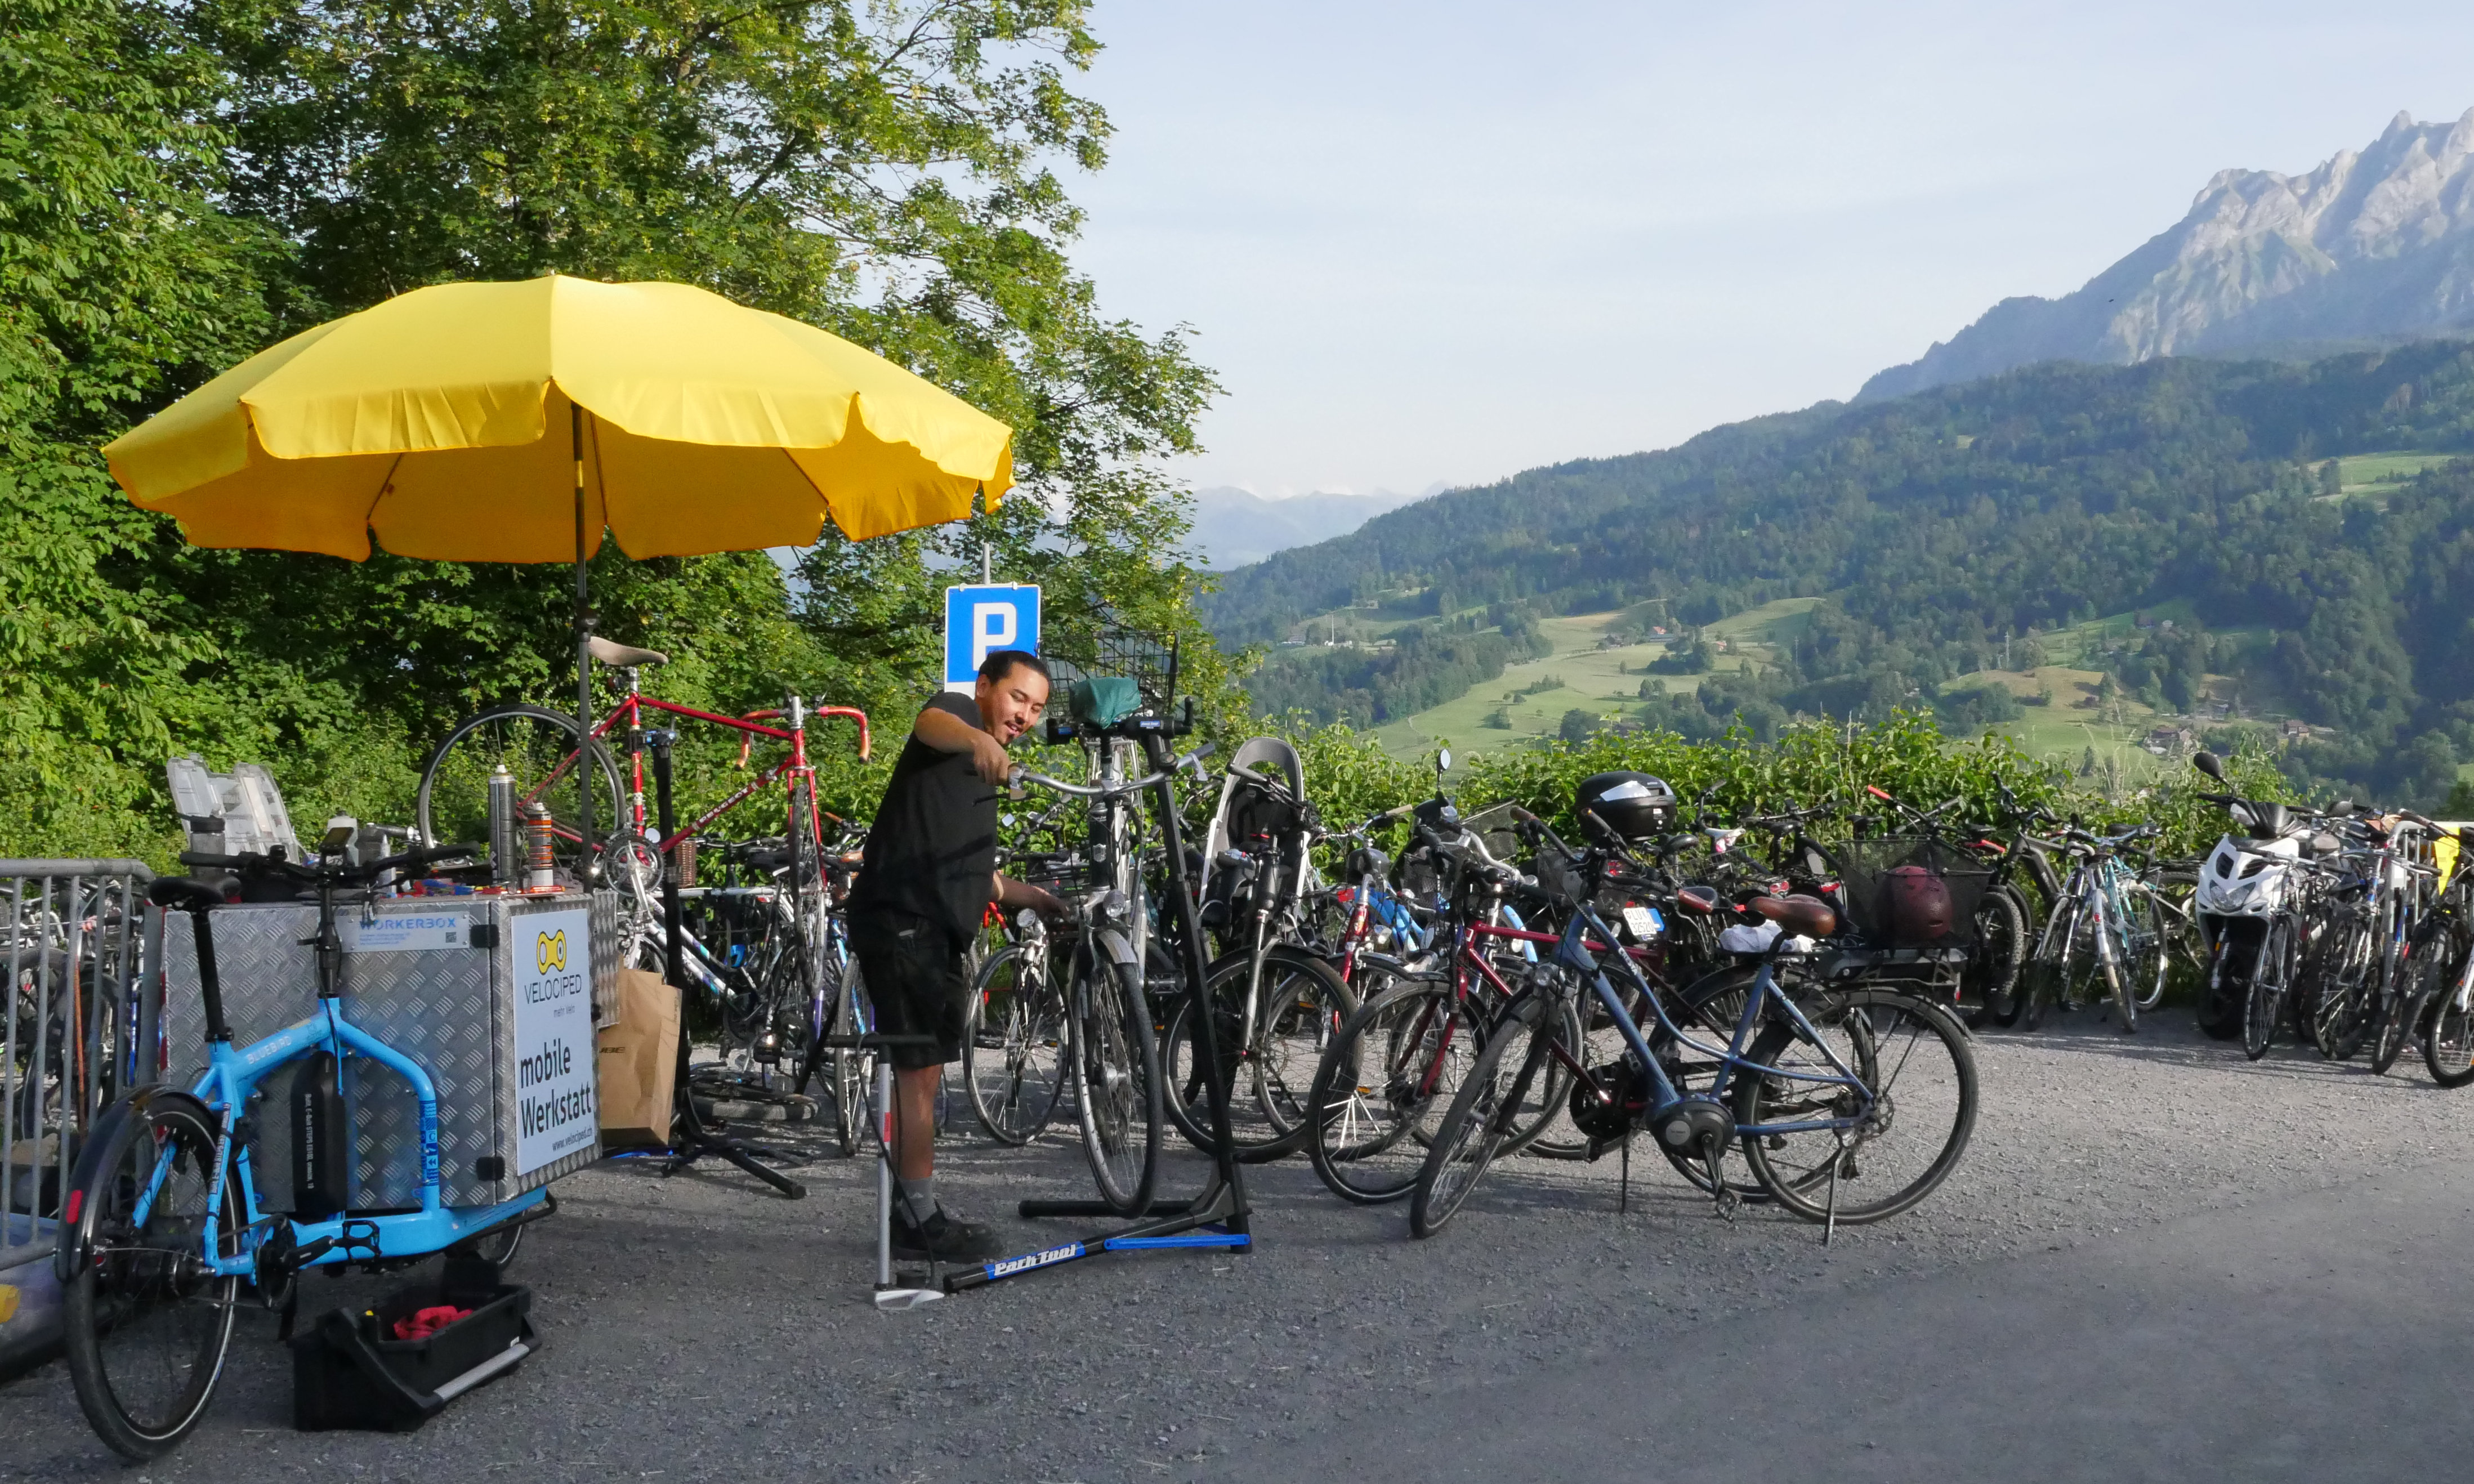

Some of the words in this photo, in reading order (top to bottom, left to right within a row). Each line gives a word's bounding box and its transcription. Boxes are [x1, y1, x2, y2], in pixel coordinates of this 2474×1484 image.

[972, 602, 1017, 671] P
[699, 787, 748, 823] PEUGEOT
[359, 917, 456, 930] WORKERBOX
[524, 974, 582, 1004] VELOCIPED
[246, 1036, 292, 1064] BLUEBIRD
[520, 1038, 571, 1089] mobile
[520, 1081, 592, 1139] Werkstatt
[552, 1125, 592, 1152] www.velociped.ch
[994, 1255, 1037, 1276] Park
[1037, 1244, 1076, 1264] Tool
